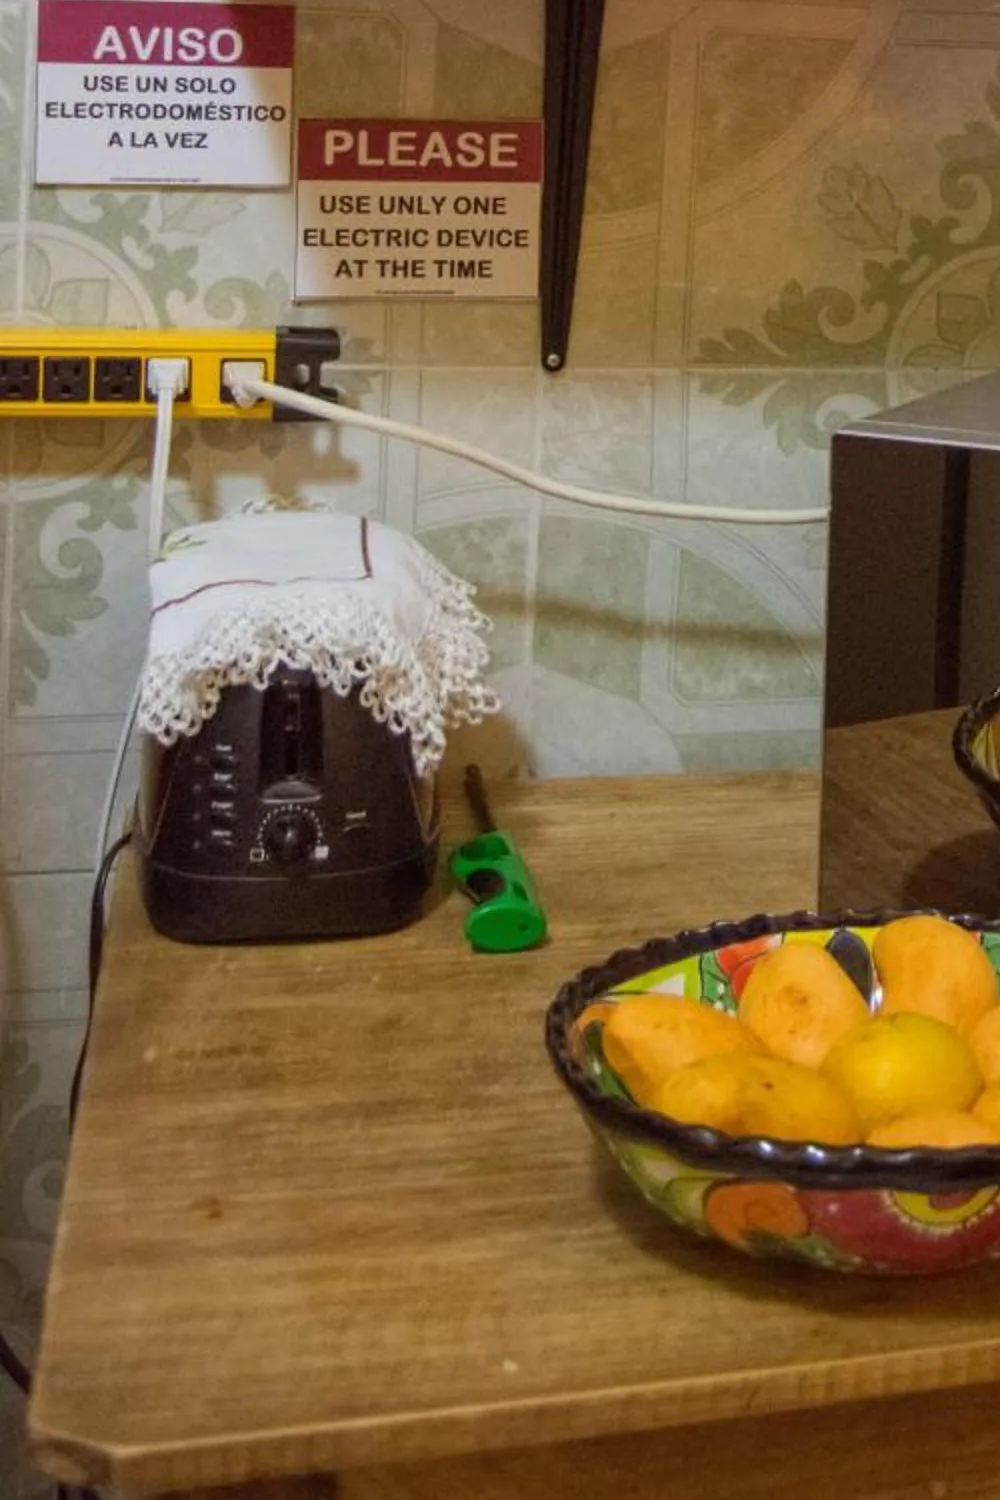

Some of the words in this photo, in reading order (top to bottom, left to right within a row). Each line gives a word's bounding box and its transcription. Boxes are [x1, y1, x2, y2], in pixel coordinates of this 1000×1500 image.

[93, 25, 243, 62] AVISO
[83, 75, 129, 93] USE
[136, 76, 168, 93] UN
[175, 77, 236, 94] SOLO
[45, 101, 286, 122] ELECTRODOMÉSTICO
[108, 131, 123, 148] A
[131, 132, 158, 148] LA
[165, 132, 208, 149] VEZ
[324, 129, 518, 168] PLEASE
[320, 195, 371, 214] USE
[379, 195, 447, 215] UNLY
[453, 197, 507, 215] ONE
[303, 229, 429, 247] ELECTRIC
[436, 229, 529, 247] DEVICE
[335, 260, 368, 278] AT
[375, 260, 426, 278] THE
[433, 260, 493, 278] TIME
